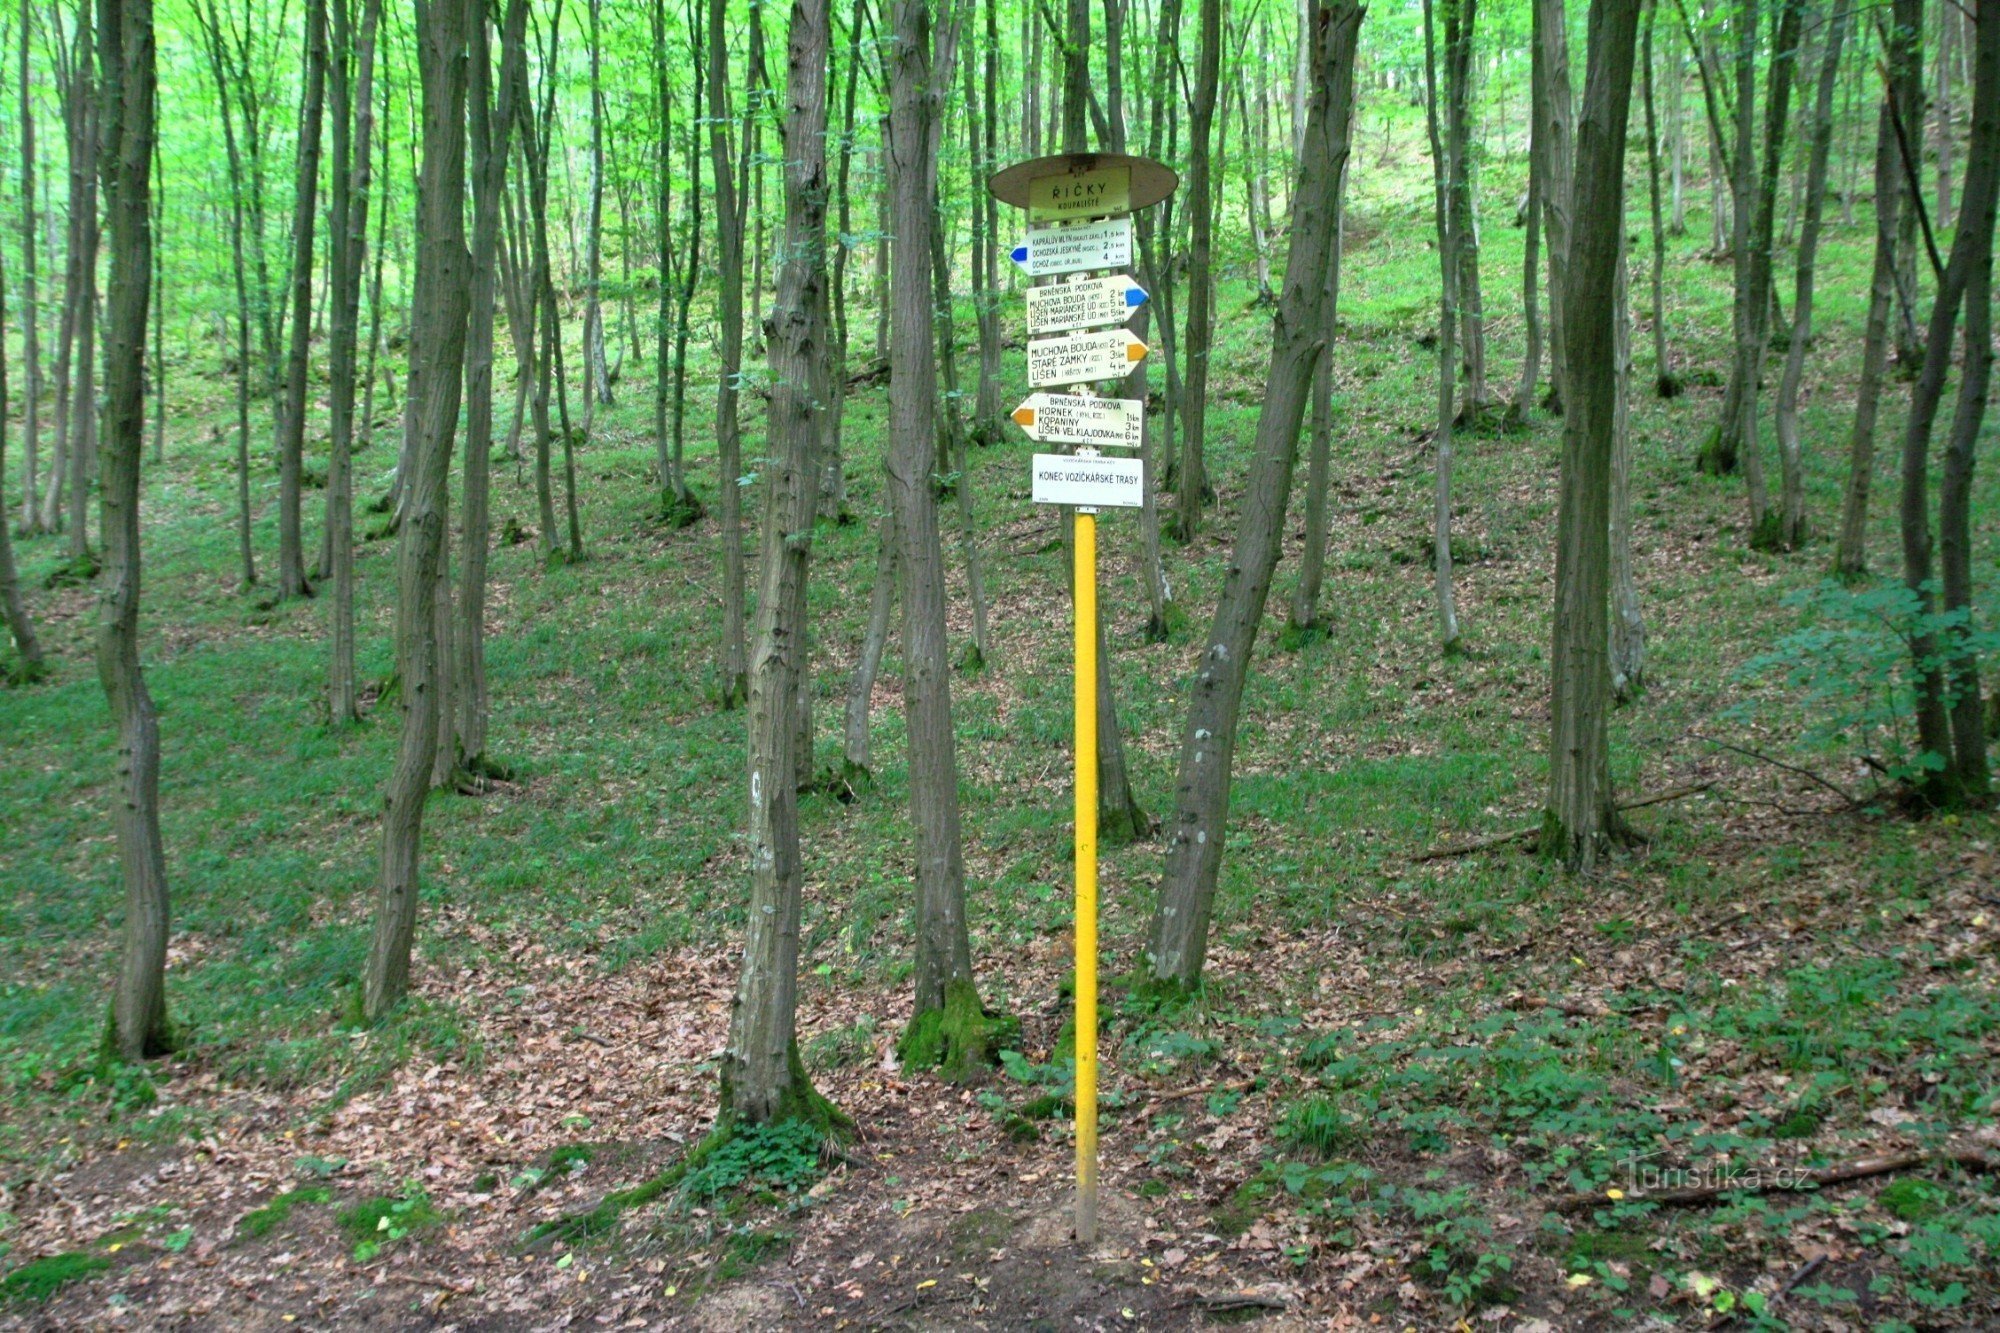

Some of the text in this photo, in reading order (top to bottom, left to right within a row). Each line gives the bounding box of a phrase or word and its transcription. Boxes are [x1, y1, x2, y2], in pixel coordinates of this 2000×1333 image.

[1053, 182, 1106, 199] ŘÍČKY
[1103, 241, 1114, 250] 2,5
[1032, 259, 1049, 269] OCHOZ
[1103, 252, 1108, 260] 4
[1040, 282, 1103, 297] BRNĚNSKÁ PODKOVA
[1030, 298, 1061, 309] MUCHOVA
[1063, 294, 1086, 304] BOUDA
[1110, 289, 1115, 298] 2
[1110, 299, 1115, 307] 5
[1118, 298, 1124, 306] km
[1031, 345, 1068, 358] MUCHOVA
[1071, 341, 1098, 353] BOUDA
[1110, 338, 1115, 348] 2
[1118, 339, 1124, 347] km
[1031, 356, 1056, 369] STARÉ
[1110, 361, 1115, 370] 4
[1050, 397, 1121, 410] BRNĚNSKÁ PODKOVA
[1039, 406, 1073, 418] HORNEK
[1039, 416, 1079, 427] KOPANINY
[1126, 422, 1131, 430] 3
[1076, 428, 1115, 439] KLAJDOVKA
[1125, 431, 1131, 440] 6
[1038, 470, 1138, 485] KONEC VOZÍČKÁŘSKÉ TRASY
